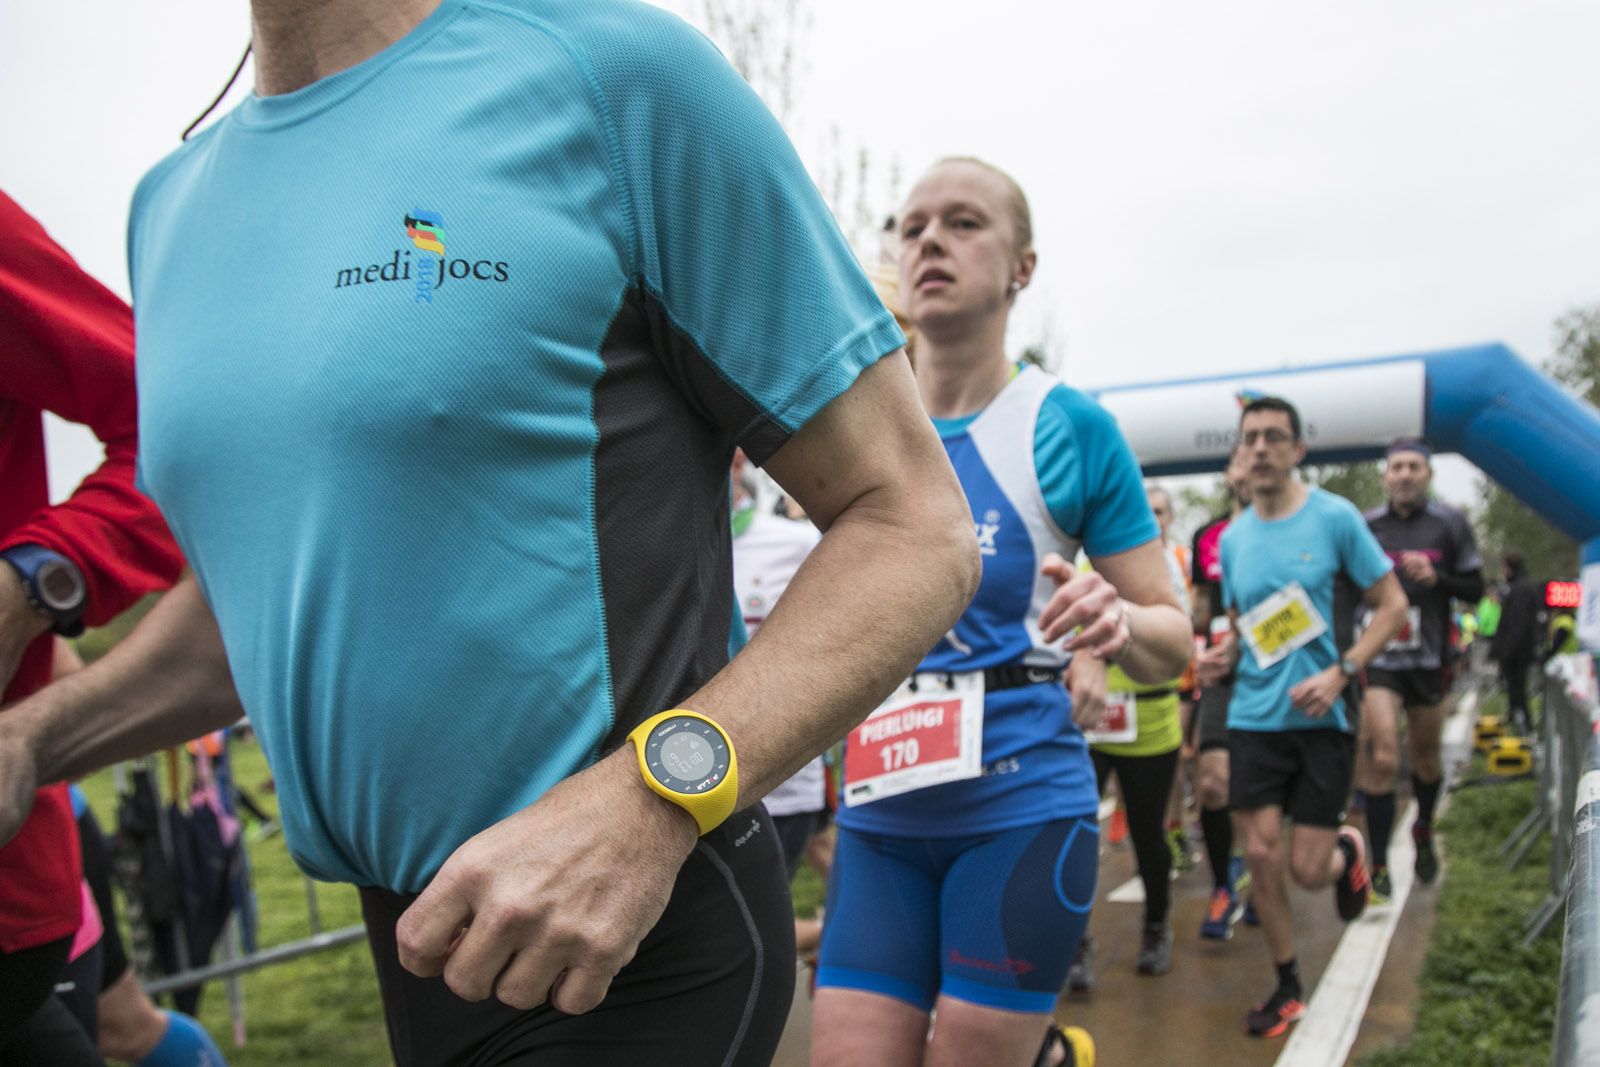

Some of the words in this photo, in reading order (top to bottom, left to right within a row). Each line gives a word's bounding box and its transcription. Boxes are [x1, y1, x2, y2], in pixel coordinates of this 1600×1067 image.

[335, 250, 411, 288] medi
[434, 257, 509, 289] jocs
[860, 706, 944, 746] PIERLUIGI
[880, 738, 919, 771] 170
[696, 774, 719, 790] POLAR
